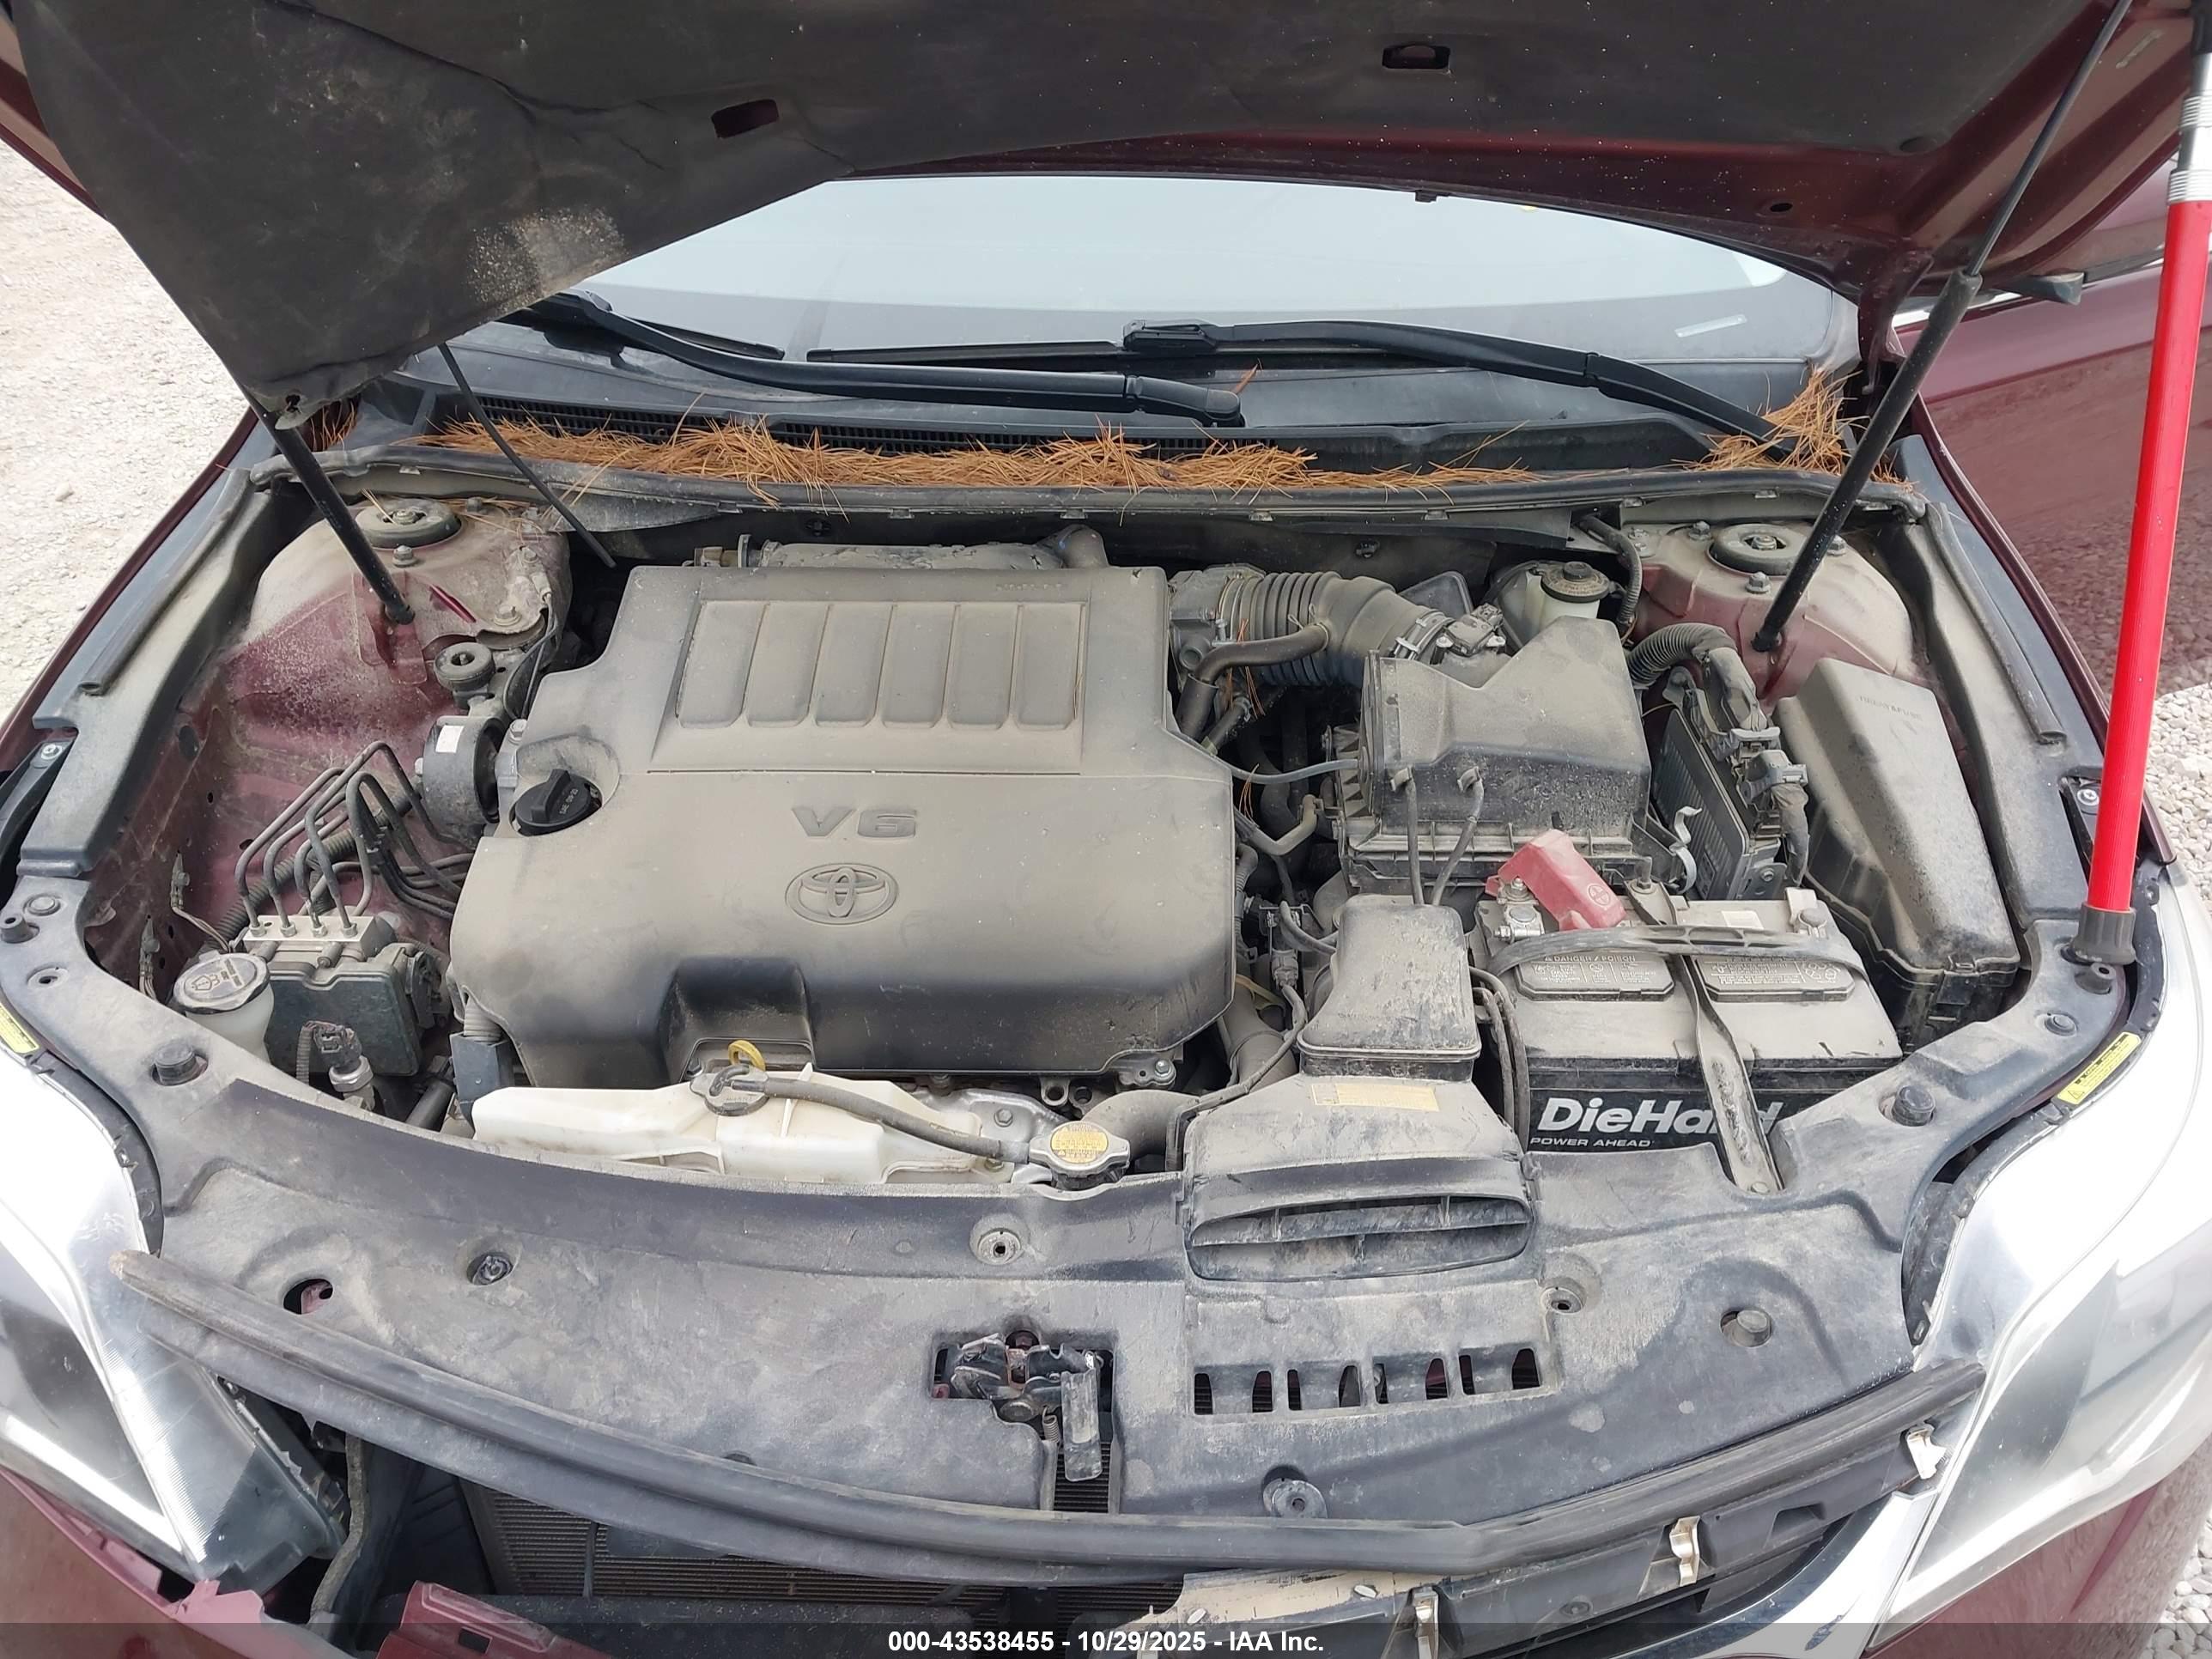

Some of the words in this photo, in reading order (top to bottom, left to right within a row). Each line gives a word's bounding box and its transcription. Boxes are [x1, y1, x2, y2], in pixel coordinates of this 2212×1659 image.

[791, 805, 917, 838] V6
[1529, 1137, 1589, 1147] POWER
[1593, 1139, 1651, 1148] AHEAD
